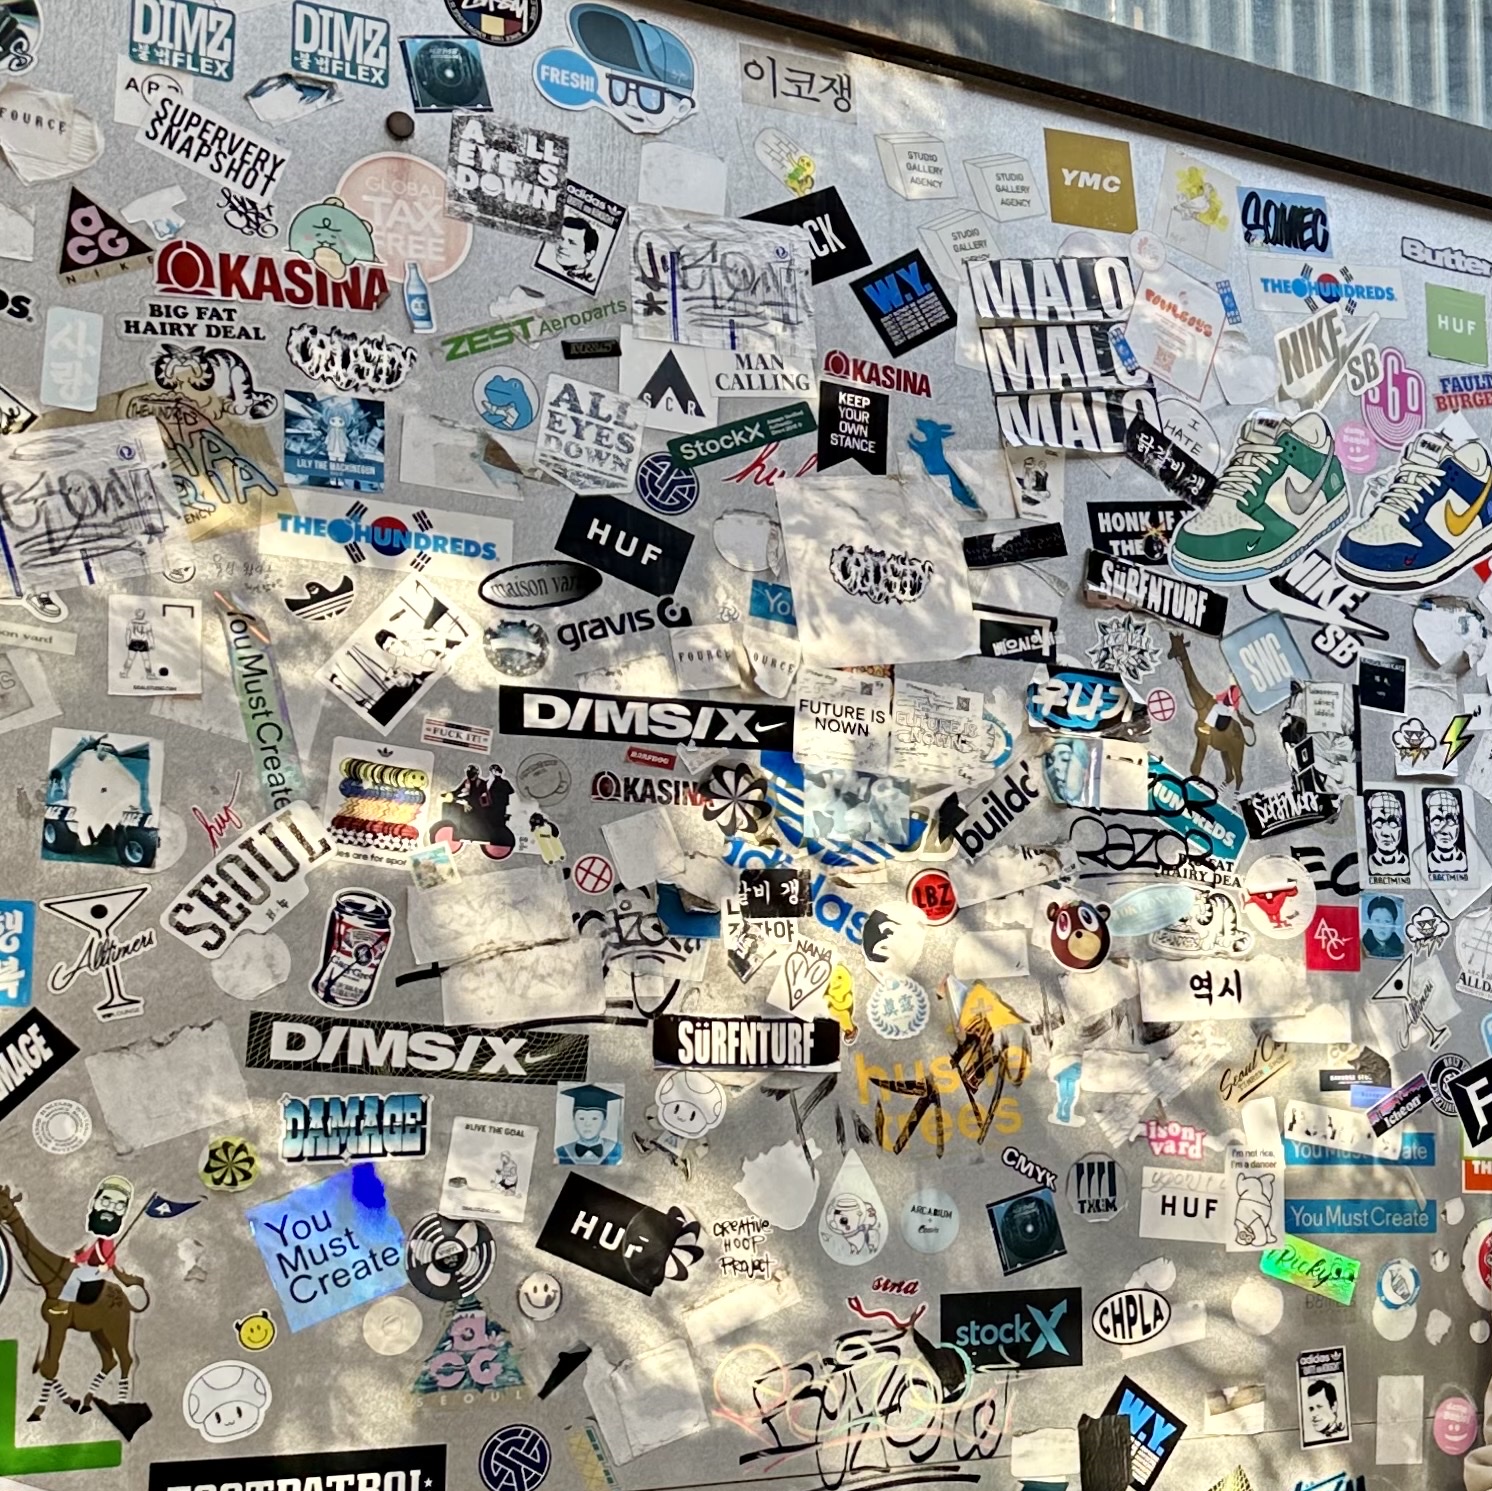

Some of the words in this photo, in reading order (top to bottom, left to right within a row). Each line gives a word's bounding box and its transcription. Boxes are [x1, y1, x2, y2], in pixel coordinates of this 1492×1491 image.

[133, 0, 232, 62] DIMZ
[295, 3, 388, 70] DIMZ
[172, 52, 229, 79] FLEX
[332, 60, 385, 86] FLEX
[539, 63, 595, 95] FRESH!
[155, 98, 286, 177] SUPERVERY
[144, 118, 277, 197] SNAPSHOT
[908, 151, 938, 162] STUDIO
[906, 163, 943, 176] GALLERY
[995, 172, 1024, 182] STUDIO
[1061, 168, 1121, 193] YMC
[365, 176, 439, 198] GLOBAL
[910, 176, 943, 189] AGENCY
[995, 183, 1030, 194] GALLERY
[362, 195, 444, 234] TAX
[952, 228, 979, 242] STUDIO
[953, 238, 988, 252] GALLERY
[970, 256, 1125, 322] MALO
[1259, 277, 1292, 293] THE
[1307, 280, 1396, 302] HUNDREDS
[149, 303, 192, 320] BIG
[196, 306, 238, 323] FAT
[1437, 313, 1476, 336] HUF
[124, 320, 198, 338] HAIRY
[205, 323, 266, 342] DEAL
[441, 316, 536, 362] ZEST
[539, 299, 628, 338] Aeroparts
[735, 353, 785, 370] MAN
[1346, 347, 1381, 390] SB
[715, 374, 811, 392] CALLING
[852, 356, 932, 398] KASINA
[550, 382, 638, 430] ALL
[838, 390, 871, 409] KEEP
[838, 405, 870, 424] YOUR
[1188, 417, 1200, 431] I
[546, 409, 636, 455] EYES
[678, 421, 765, 461] StockX
[838, 421, 869, 439] OWN
[1164, 420, 1203, 455] HATE
[830, 432, 877, 455] STANCE
[314, 460, 328, 471] THE
[1098, 512, 1151, 533] HONK
[277, 512, 327, 538] THE
[353, 520, 498, 561] HUNDREDS
[586, 517, 663, 568] HUF
[1109, 539, 1144, 556] THE
[557, 606, 656, 651] gravis
[1318, 624, 1359, 666] SB
[799, 699, 865, 721] FUTURE
[872, 709, 886, 724] IS
[814, 717, 870, 737] NOWN
[370, 853, 384, 863] for
[168, 809, 333, 952] SEOUL
[796, 940, 832, 964] NANA
[1190, 969, 1242, 1007] 역시
[1384, 1096, 1422, 1129] Icheon
[284, 1099, 427, 1162] DAMAGE
[488, 1125, 504, 1136] THE
[1001, 1147, 1057, 1191] CMYK
[1160, 1195, 1218, 1219] HUF
[1290, 1206, 1325, 1227] You
[1326, 1208, 1368, 1226] Must
[1371, 1208, 1429, 1227] Create
[264, 1208, 333, 1248] You
[276, 1225, 360, 1280] Must
[723, 1236, 766, 1253] HOOP
[288, 1243, 400, 1304] Create
[1278, 1244, 1332, 1289] Ricky
[956, 1299, 1069, 1358] stockX
[1099, 1293, 1165, 1339] CHPLA
